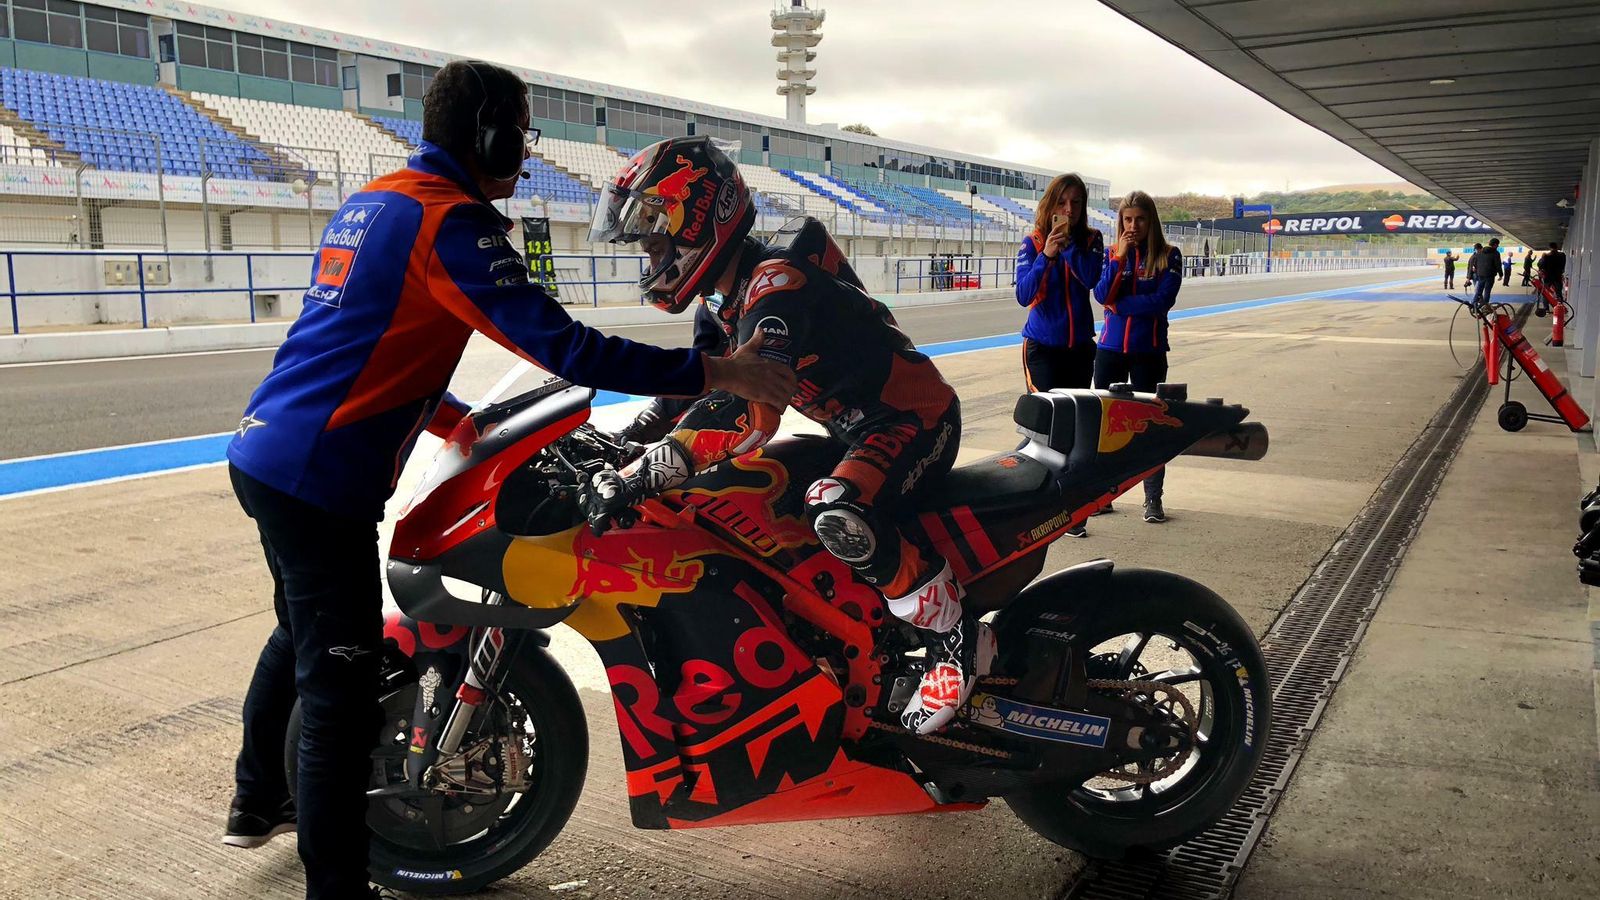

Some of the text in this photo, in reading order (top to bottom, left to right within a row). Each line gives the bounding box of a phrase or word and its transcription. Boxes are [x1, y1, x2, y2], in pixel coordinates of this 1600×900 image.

[1284, 216, 1362, 232] REPSOL
[1407, 214, 1491, 230] REPSO
[477, 235, 506, 249] elf
[1006, 710, 1105, 736] MICHELIN
[1243, 687, 1254, 747] MICHELIN
[396, 869, 444, 879] MICHELIN
